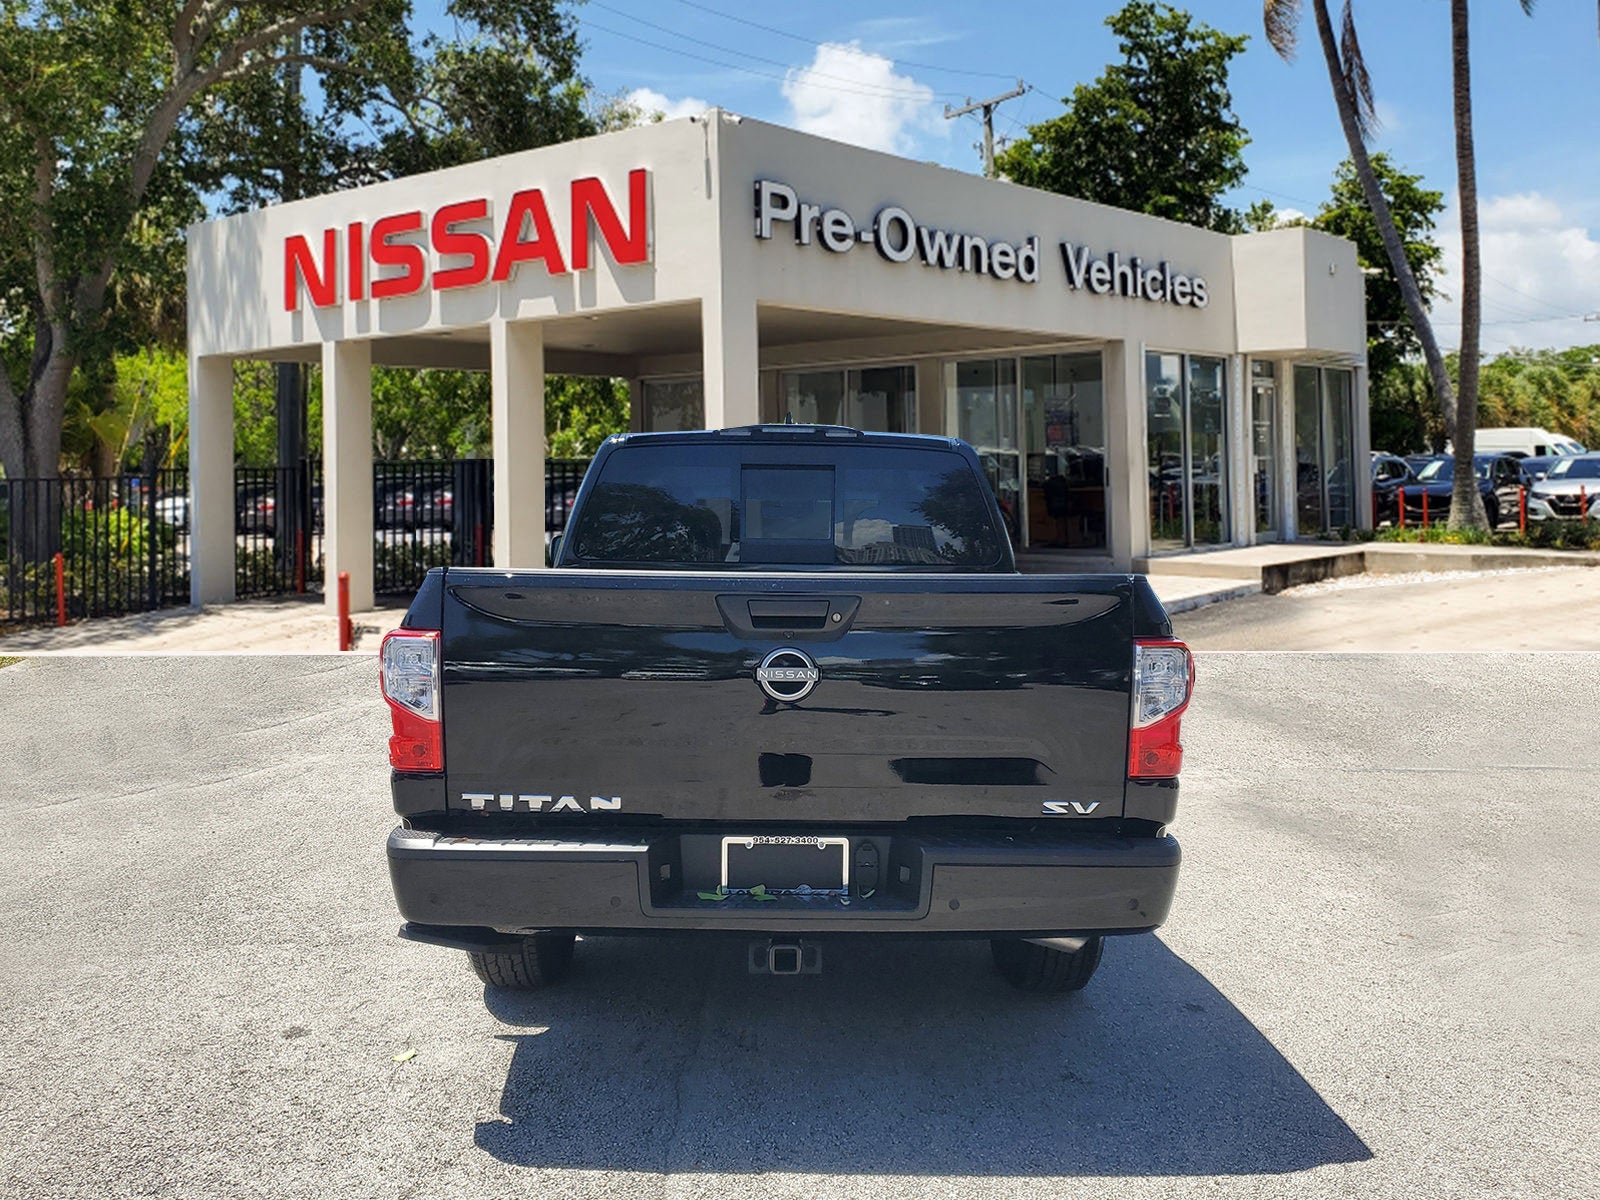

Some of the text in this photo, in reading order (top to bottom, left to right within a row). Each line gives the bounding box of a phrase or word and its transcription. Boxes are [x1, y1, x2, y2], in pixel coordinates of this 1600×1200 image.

[285, 168, 647, 312] NISSAN
[754, 179, 1209, 308] Pre-Owned Vehicles
[759, 670, 817, 679] NISSAN
[461, 793, 622, 813] TITAN
[1041, 800, 1100, 815] SV
